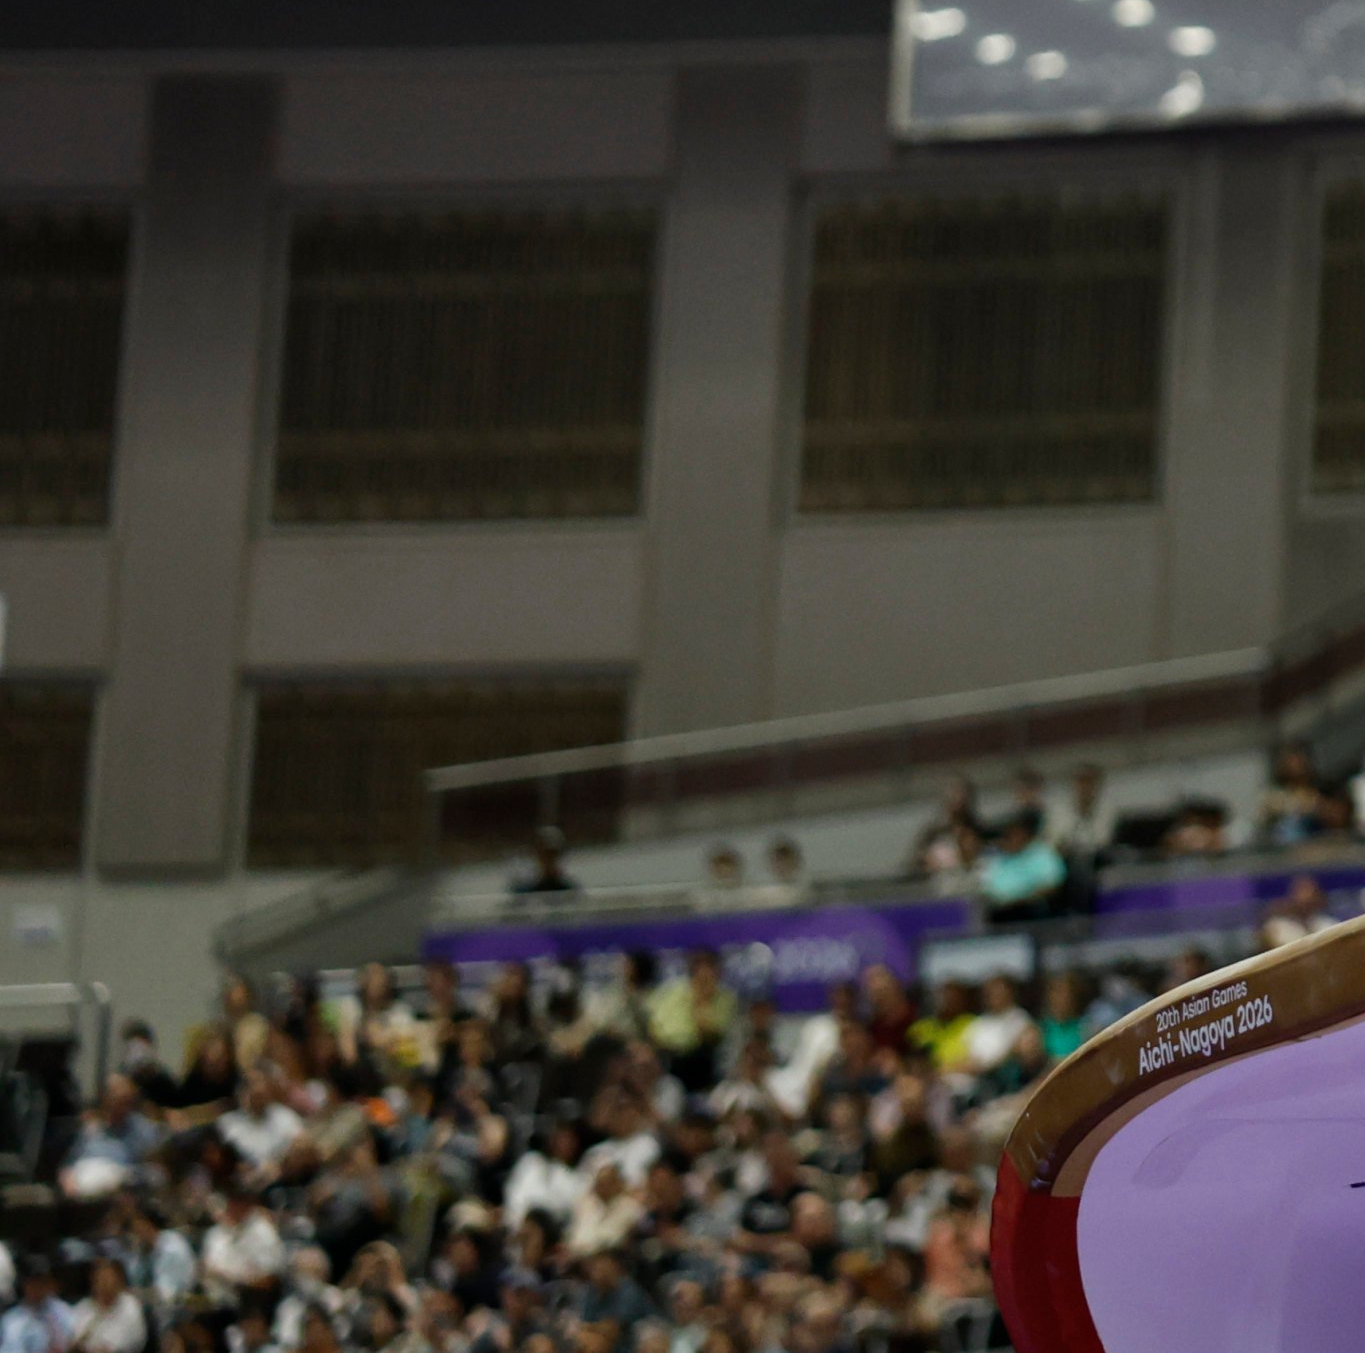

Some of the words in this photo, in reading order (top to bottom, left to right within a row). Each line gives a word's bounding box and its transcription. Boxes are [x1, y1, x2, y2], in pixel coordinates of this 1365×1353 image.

[1139, 1014, 1235, 1076] Aichi-Nagoya
[1237, 994, 1273, 1034] 2026
[1156, 1007, 1180, 1032] 20th
[1182, 997, 1210, 1021] Asian
[1212, 981, 1248, 1007] Games
